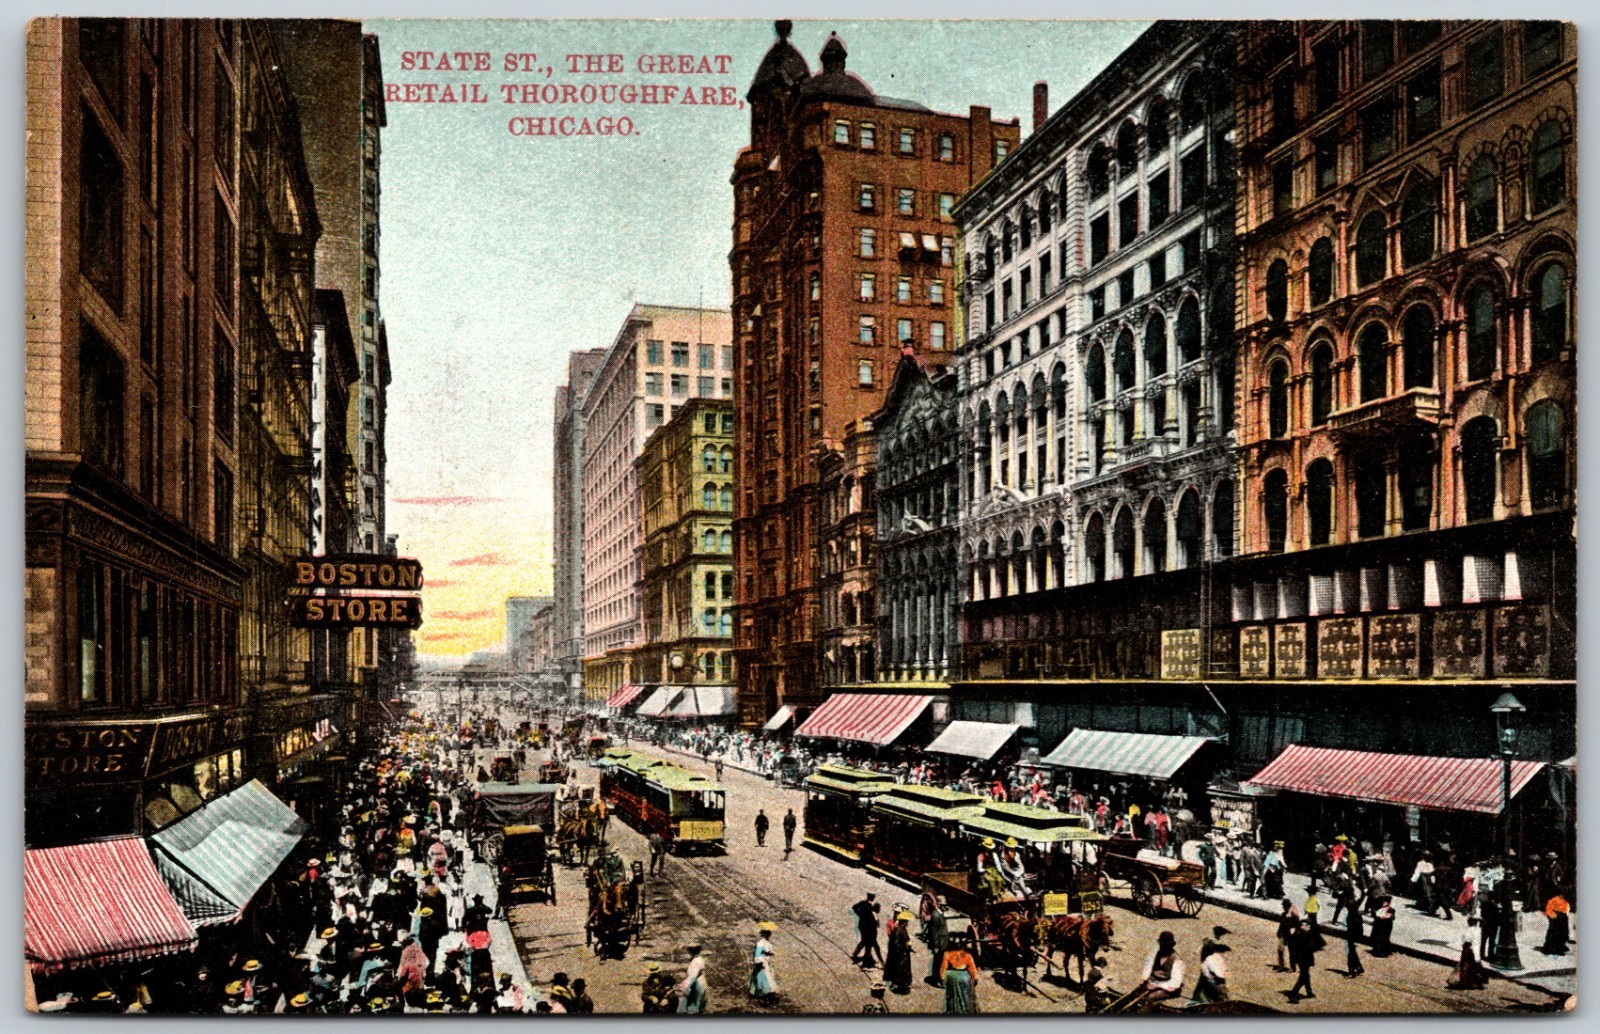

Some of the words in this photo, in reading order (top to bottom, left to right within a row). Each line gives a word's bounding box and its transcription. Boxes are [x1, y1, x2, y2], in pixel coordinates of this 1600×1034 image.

[296, 561, 417, 588] BOSTON
[305, 598, 408, 622] STORE
[30, 728, 142, 749] OSTON
[38, 753, 124, 775] TORE
